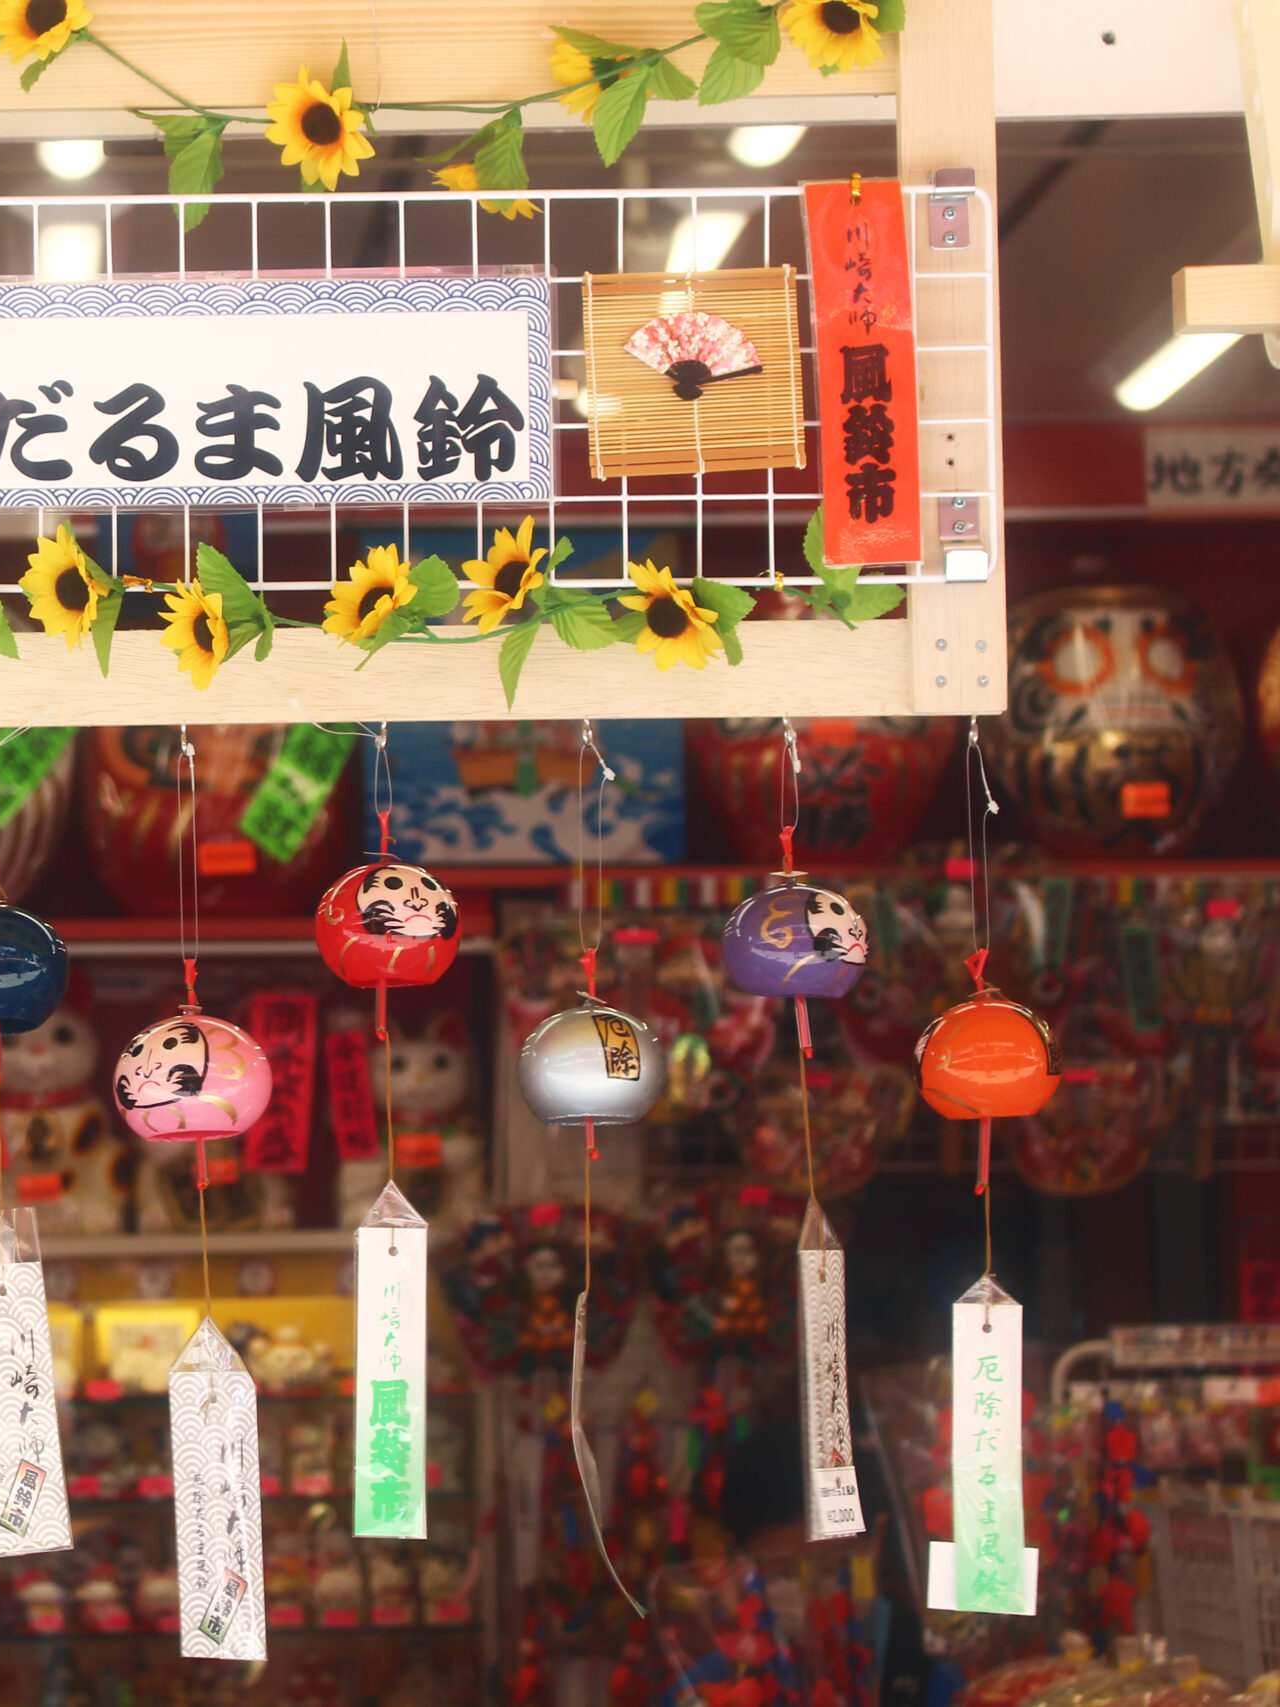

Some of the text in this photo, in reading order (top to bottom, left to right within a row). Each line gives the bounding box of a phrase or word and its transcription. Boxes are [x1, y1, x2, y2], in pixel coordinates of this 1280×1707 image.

[839, 222, 896, 523] 川崎大師 風鈴市
[971, 1354, 1008, 1597] 厄除だるま風鈴
